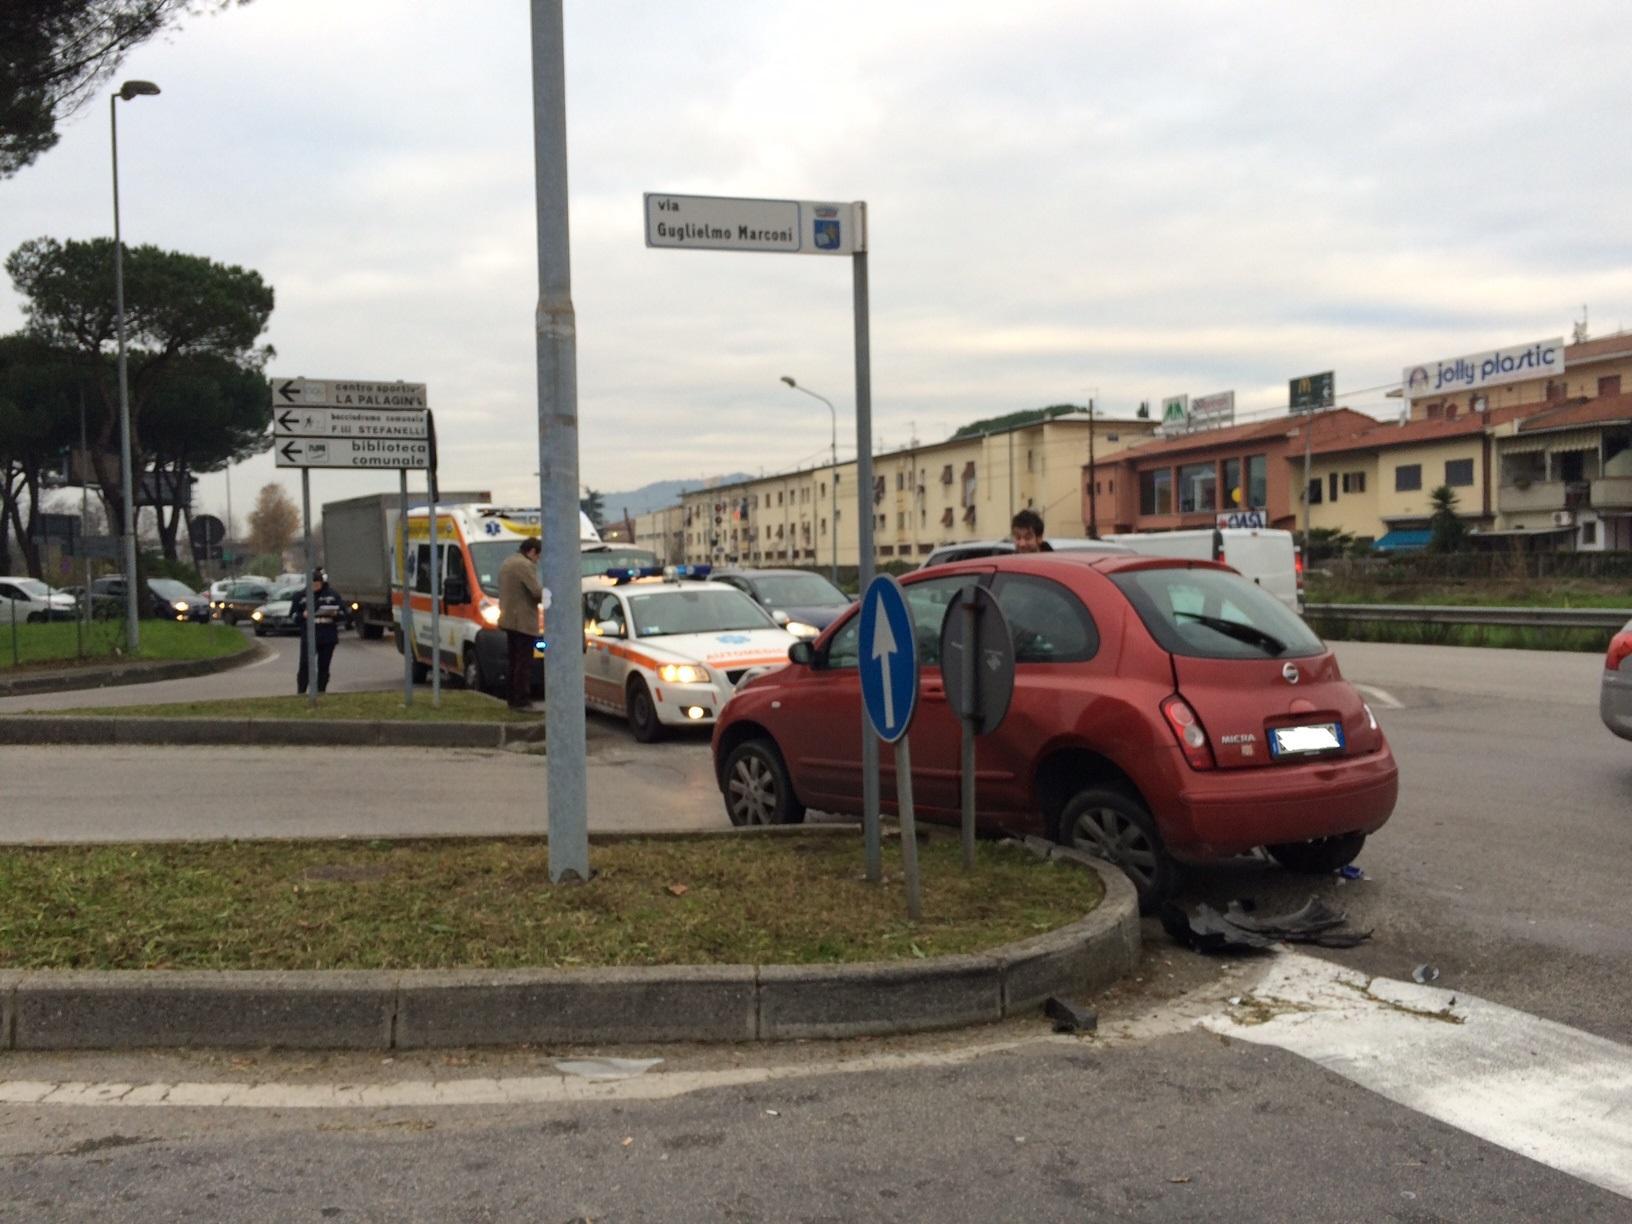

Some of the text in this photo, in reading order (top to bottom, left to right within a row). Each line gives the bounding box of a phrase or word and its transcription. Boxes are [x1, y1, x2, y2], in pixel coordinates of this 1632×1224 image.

[658, 199, 679, 211] via
[657, 223, 793, 242] Guglielmo Marconi
[1435, 345, 1556, 389] jolly plastic
[336, 383, 373, 392] centro
[336, 394, 353, 404] LA
[352, 440, 426, 453] biblioteca
[352, 456, 425, 466] comunale
[1221, 734, 1256, 744] MICRA
